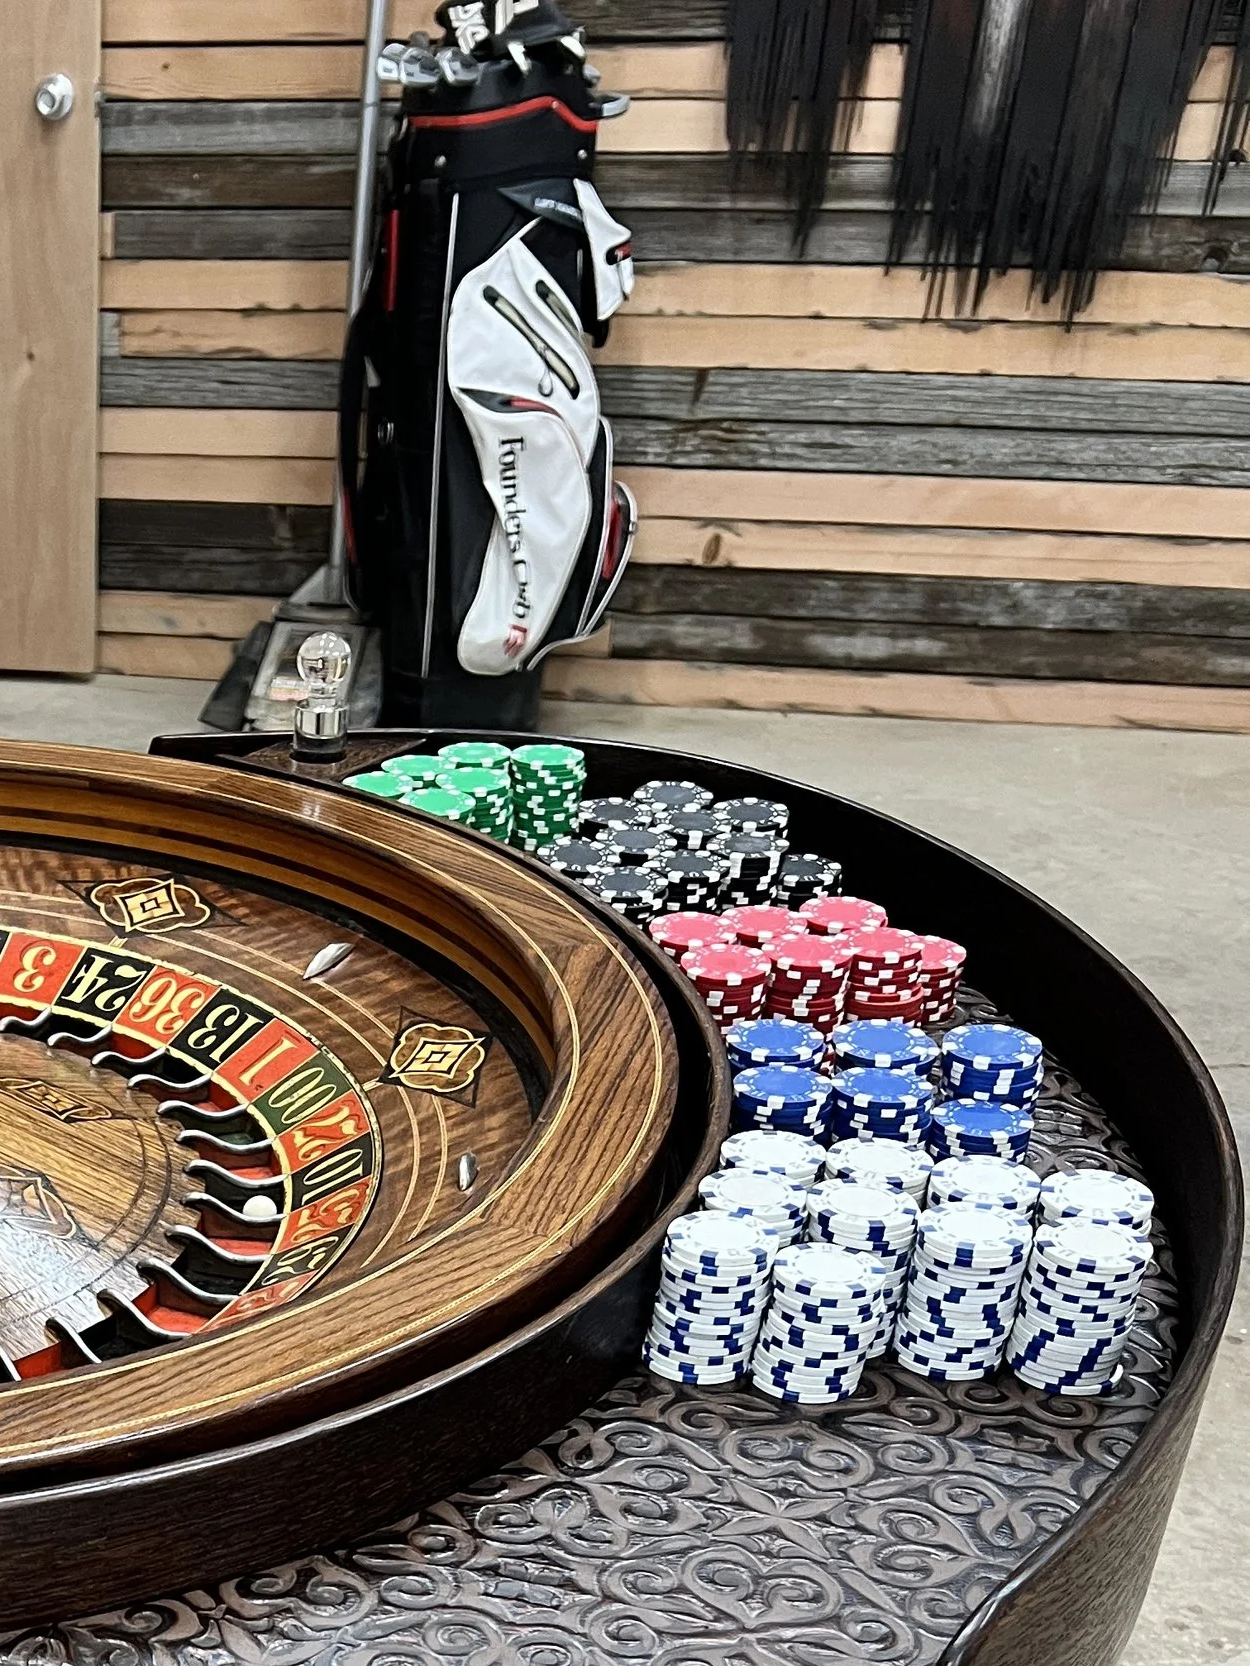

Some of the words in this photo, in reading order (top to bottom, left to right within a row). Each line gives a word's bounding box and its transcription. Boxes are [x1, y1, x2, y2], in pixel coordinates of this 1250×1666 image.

[13, 945, 57, 993] 3
[61, 954, 147, 1012] 24
[129, 977, 206, 1036] 36
[187, 1003, 264, 1064] 13
[237, 1036, 300, 1087] 1
[268, 1066, 337, 1125] 00
[293, 1105, 358, 1161] 27
[300, 1148, 364, 1206] 10
[290, 1188, 360, 1242] 25
[261, 1235, 339, 1286] 29
